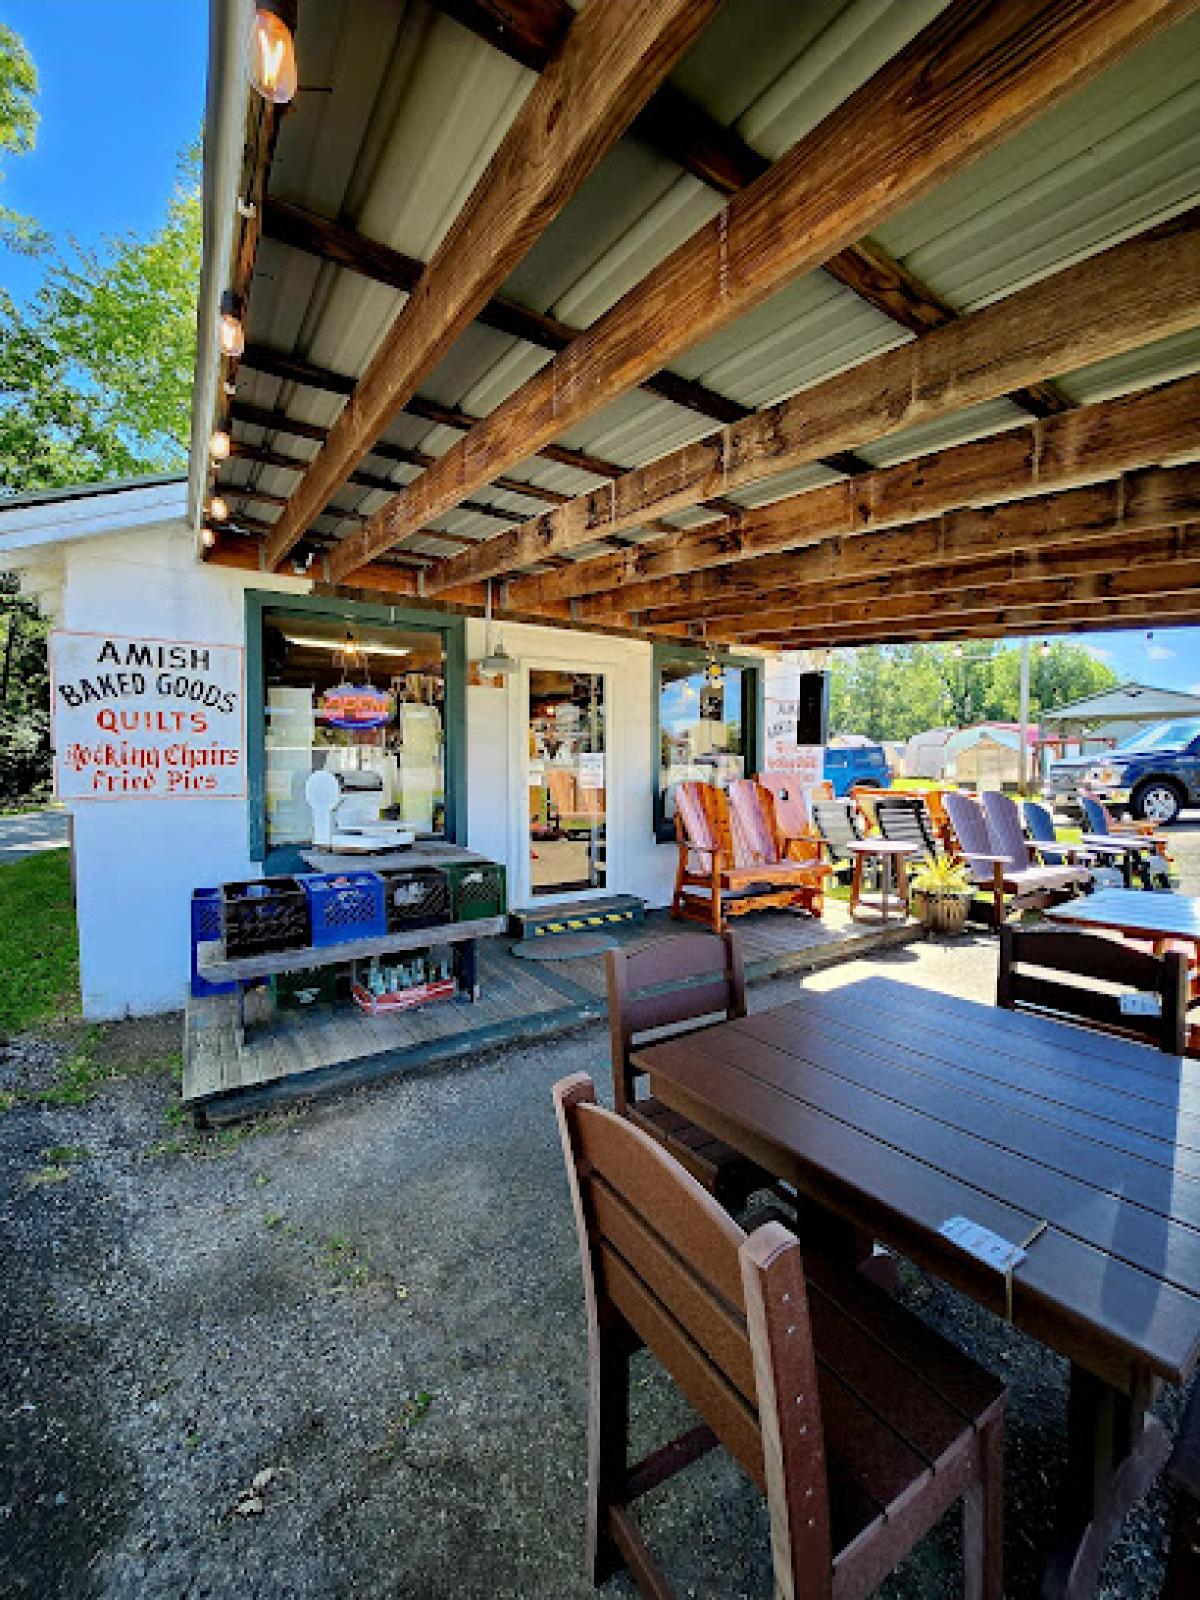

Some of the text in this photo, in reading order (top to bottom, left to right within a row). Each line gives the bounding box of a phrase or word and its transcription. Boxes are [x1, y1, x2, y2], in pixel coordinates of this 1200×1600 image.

[97, 641, 210, 671] AMISH
[58, 673, 238, 714] BAKED GOODS
[96, 708, 208, 735] QUILTS
[65, 741, 239, 771] Rocking Chairs
[93, 770, 218, 792] Fried Pies
